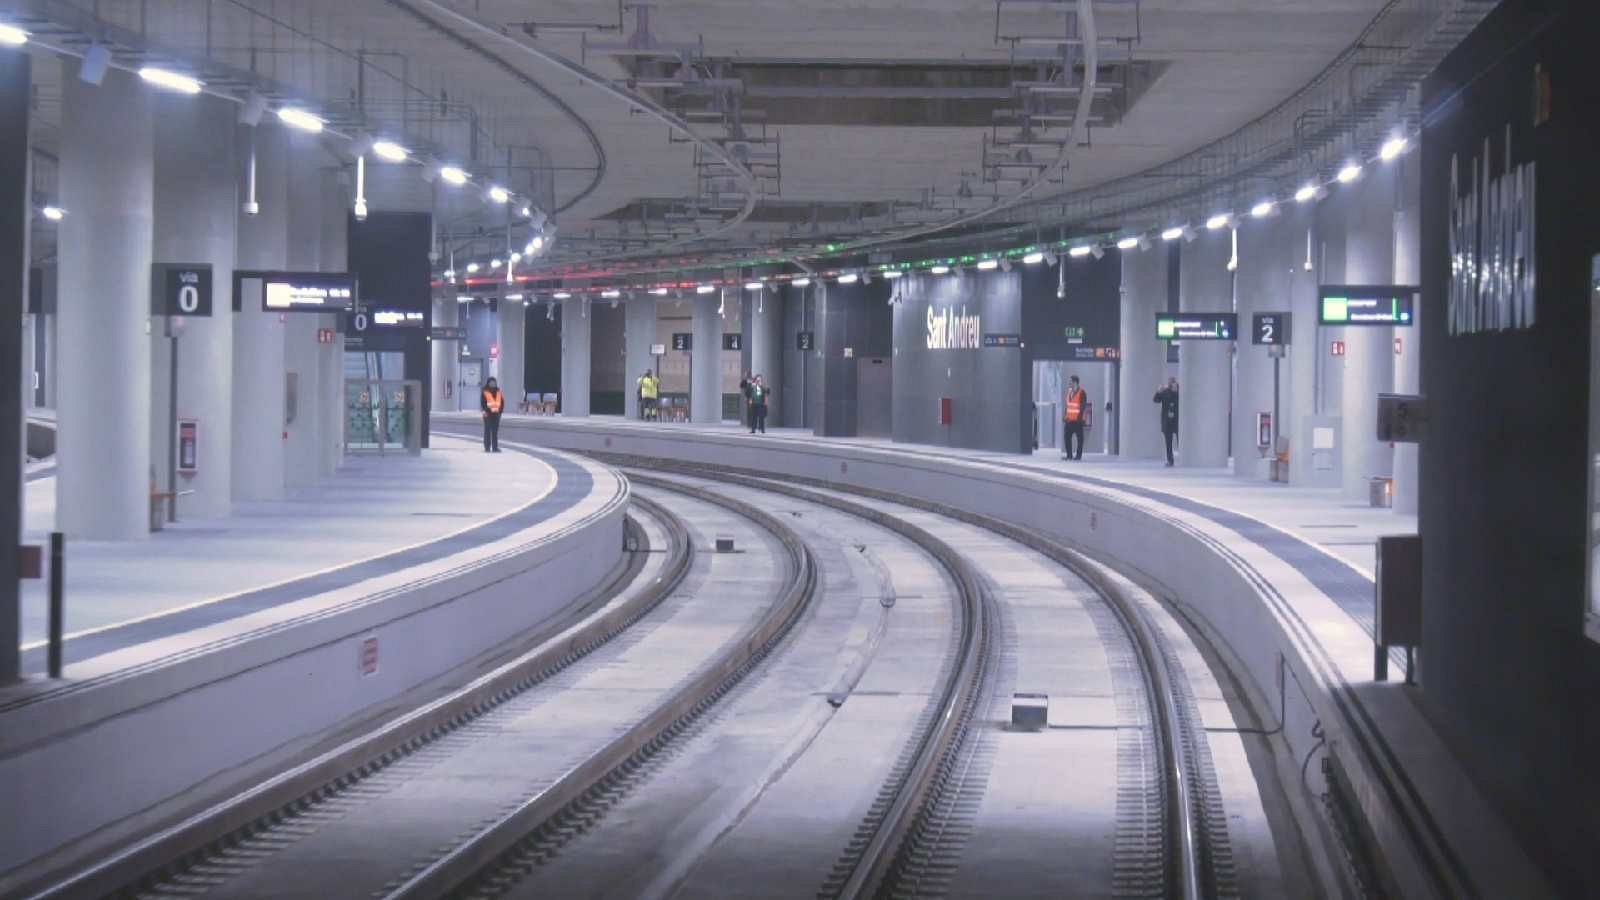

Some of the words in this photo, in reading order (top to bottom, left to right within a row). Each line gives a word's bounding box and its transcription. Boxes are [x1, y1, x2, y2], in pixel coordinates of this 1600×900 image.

[180, 286, 198, 312] 0
[355, 313, 367, 331] 0
[927, 304, 946, 349] Sant
[948, 304, 979, 349] Andreu
[1262, 325, 1273, 342] 2
